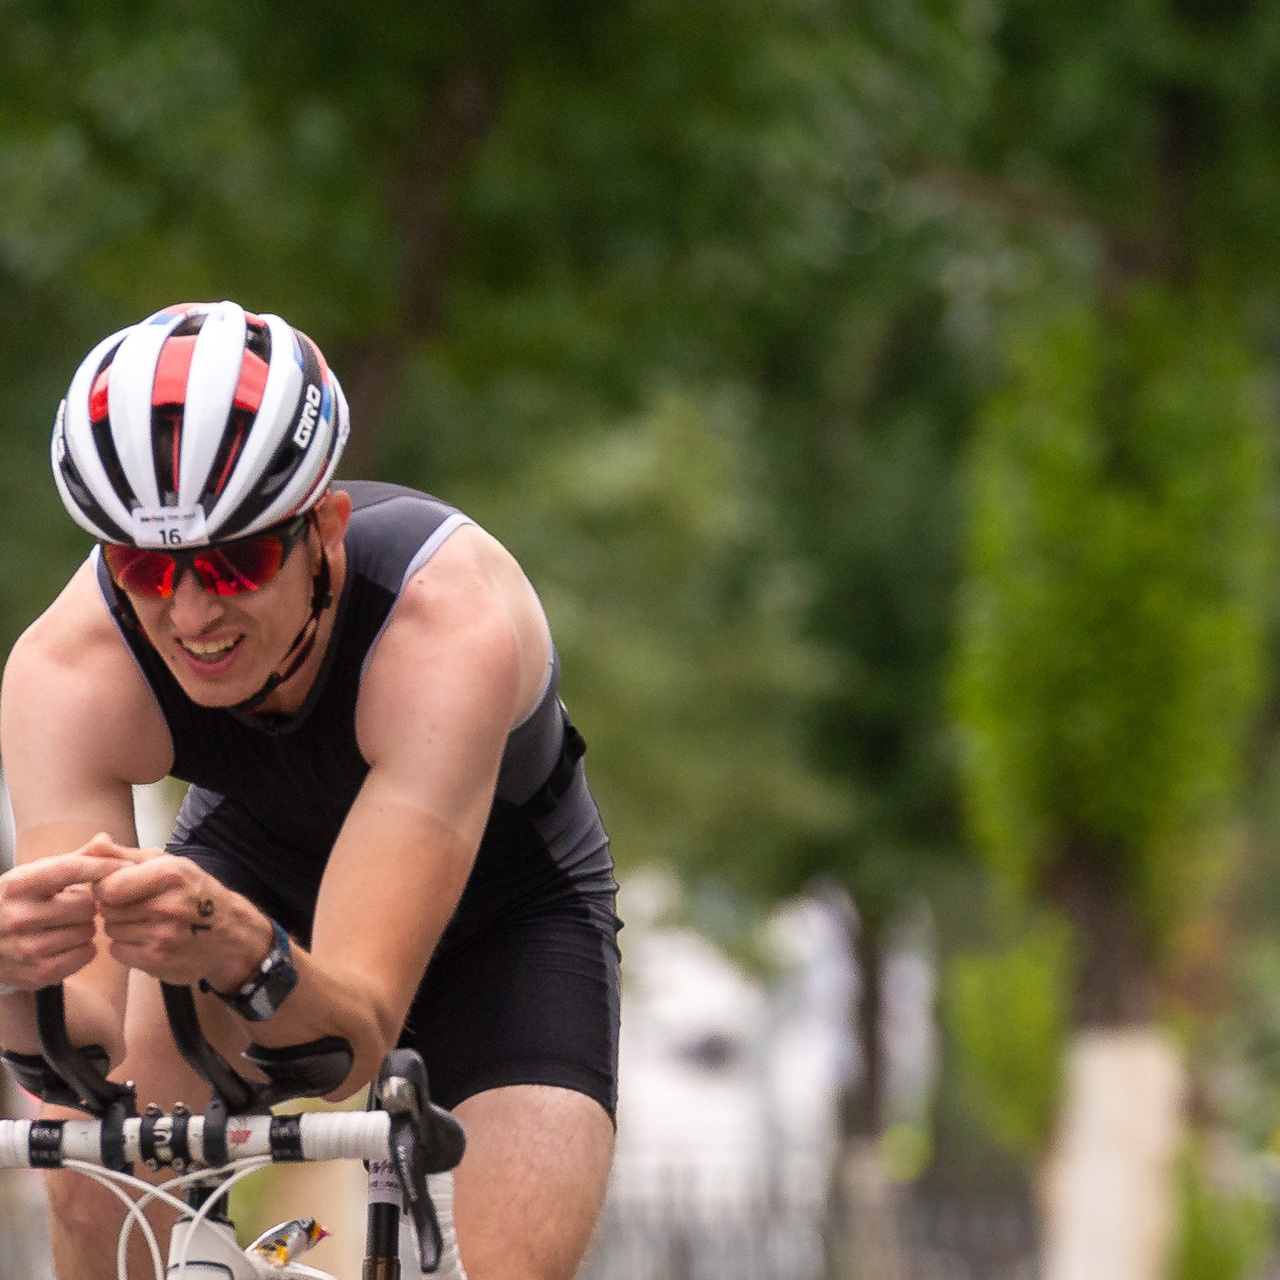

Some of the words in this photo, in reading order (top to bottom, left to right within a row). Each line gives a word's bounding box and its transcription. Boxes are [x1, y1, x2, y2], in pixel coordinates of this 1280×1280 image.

[293, 384, 321, 449] GIRO
[160, 528, 182, 545] 16
[190, 899, 214, 935] 16
